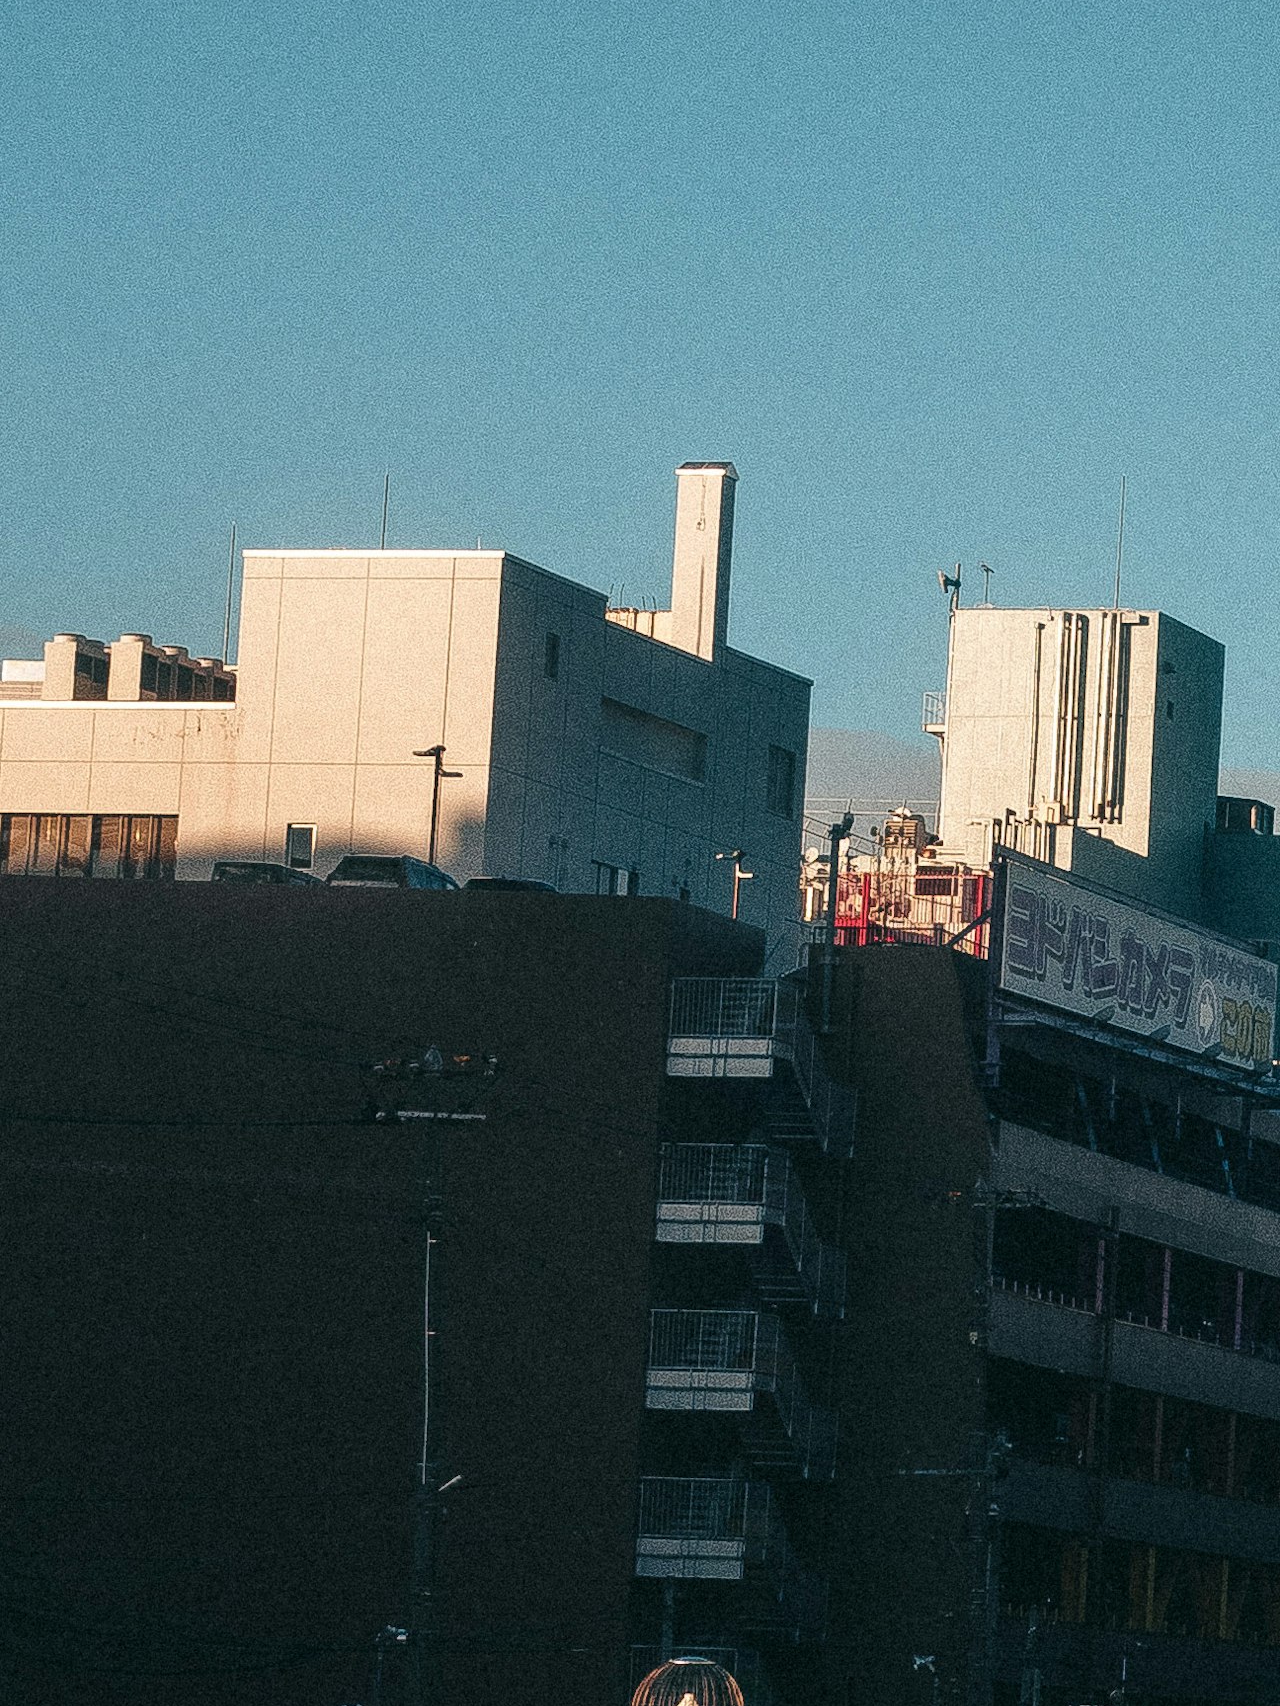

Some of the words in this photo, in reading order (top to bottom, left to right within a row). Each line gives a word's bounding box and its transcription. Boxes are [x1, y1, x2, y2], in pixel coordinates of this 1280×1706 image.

[1008, 884, 1195, 1030] ヨドバシカメラ
